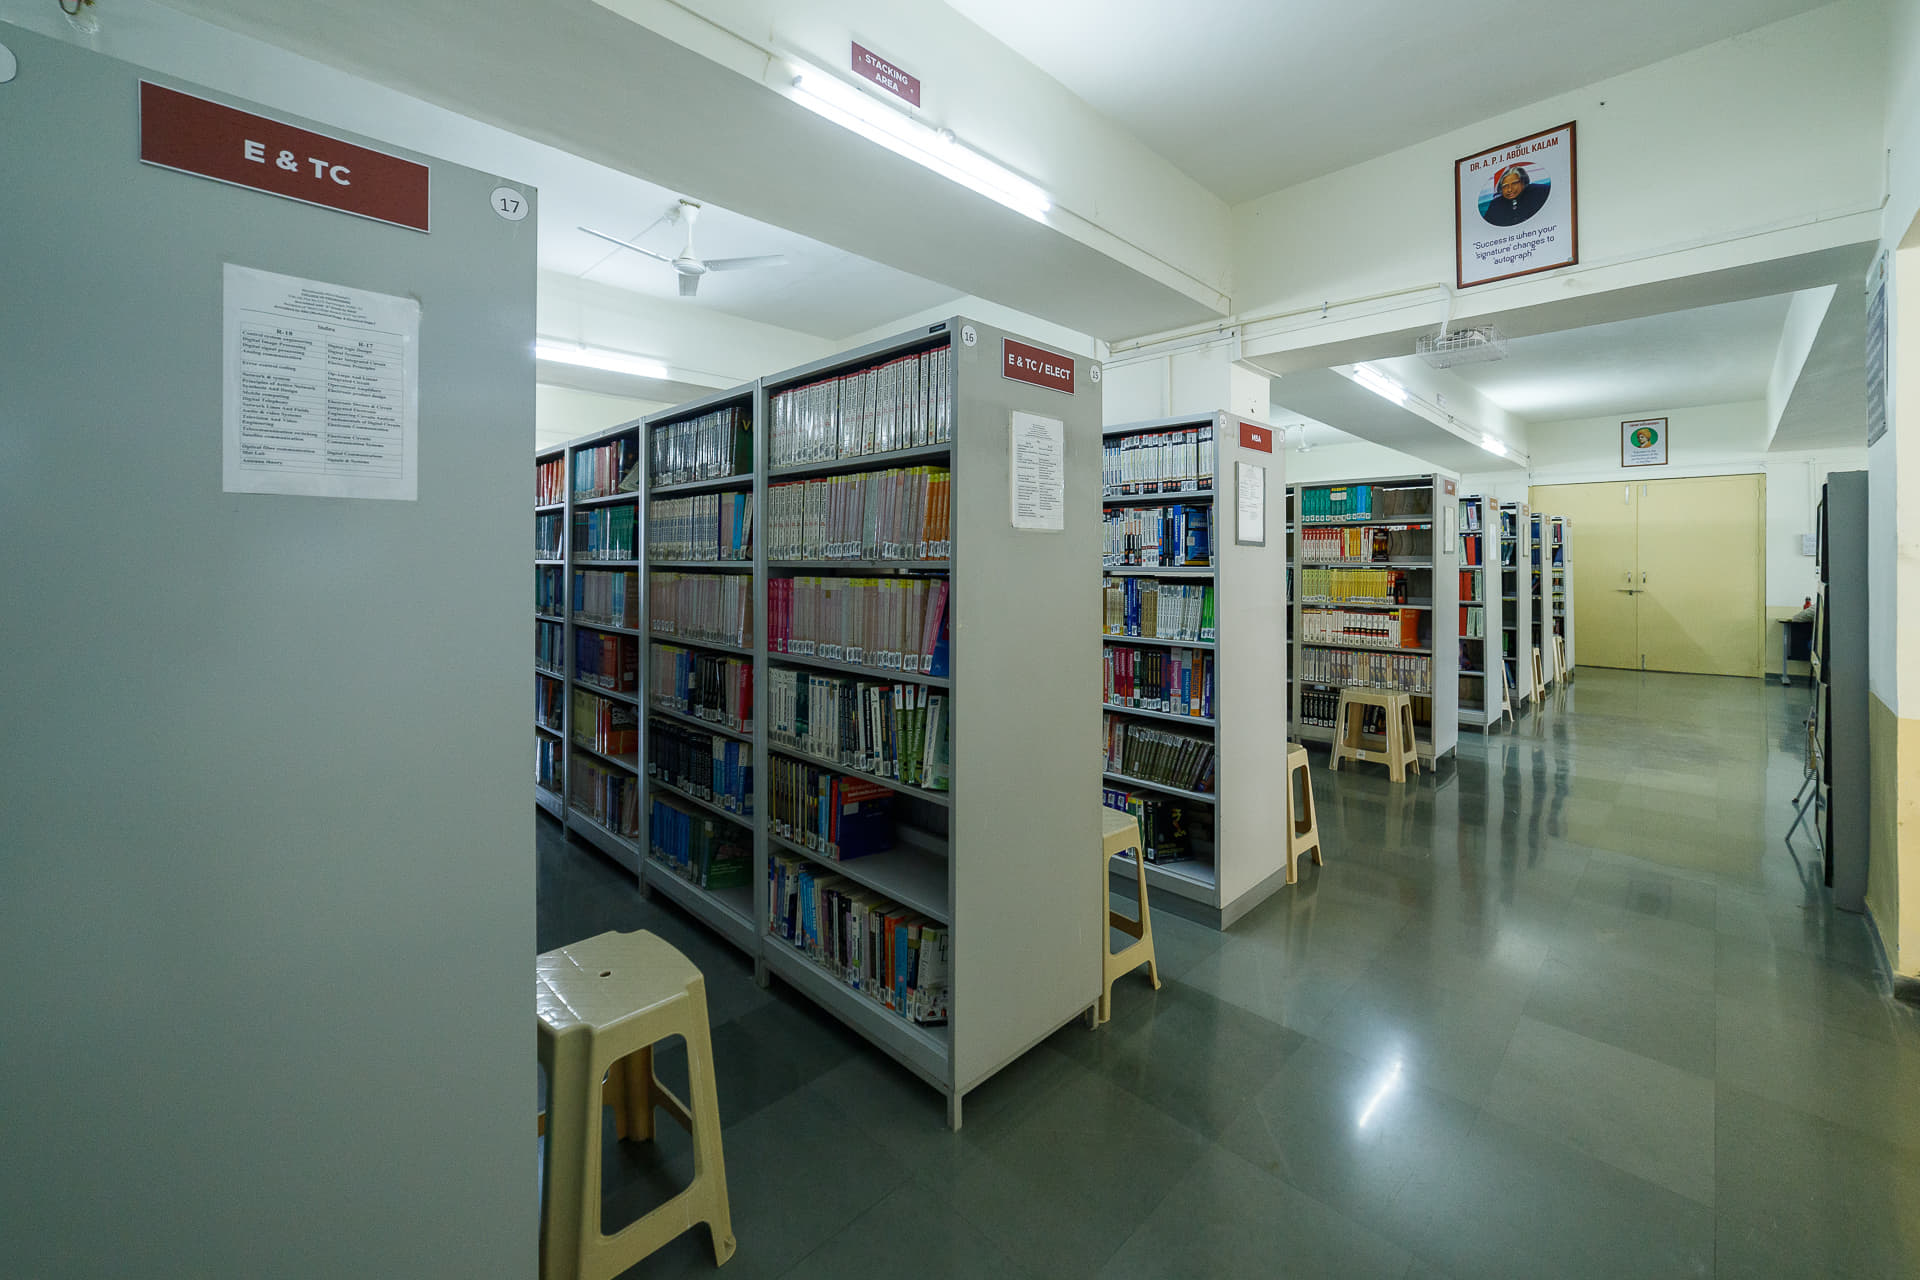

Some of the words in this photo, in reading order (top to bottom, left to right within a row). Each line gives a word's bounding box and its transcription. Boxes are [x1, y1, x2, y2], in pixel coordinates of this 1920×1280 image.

[865, 54, 908, 85] STACKING
[876, 73, 898, 92] AREA
[244, 139, 265, 164] E
[275, 150, 299, 173] &
[308, 157, 351, 186] TC
[1470, 162, 1481, 172] DR.
[1483, 159, 1490, 168] A.
[1492, 157, 1498, 165] P.
[1506, 146, 1530, 160] ABDUL
[1531, 137, 1558, 152] KALAM
[500, 197, 520, 215] 17
[1516, 230, 1536, 240] when
[1538, 224, 1557, 238] your
[1512, 238, 1545, 251] changes
[964, 332, 974, 343] 16
[1008, 353, 1014, 365] E
[1016, 356, 1024, 368] &
[1025, 358, 1037, 371] TC
[1038, 362, 1044, 374] /
[1045, 363, 1071, 381] ELECT
[1092, 370, 1099, 380] 15
